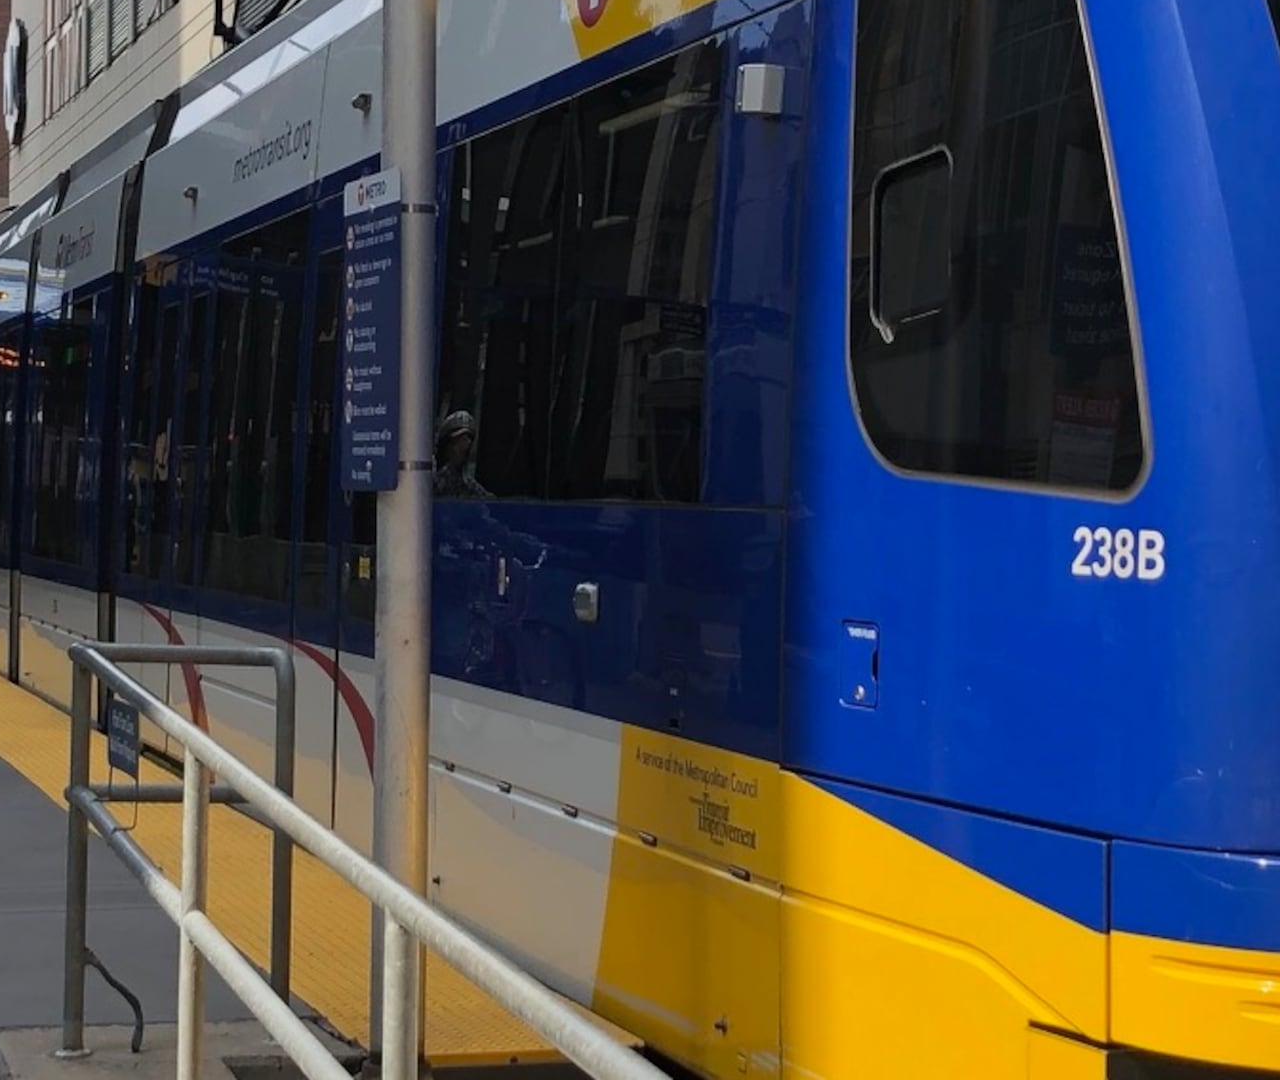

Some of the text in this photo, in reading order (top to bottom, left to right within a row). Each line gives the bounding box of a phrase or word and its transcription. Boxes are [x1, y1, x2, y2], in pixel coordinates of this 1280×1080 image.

[232, 119, 312, 183] metrotransit.org
[1071, 526, 1166, 580] 238B
[730, 772, 759, 799] Council
